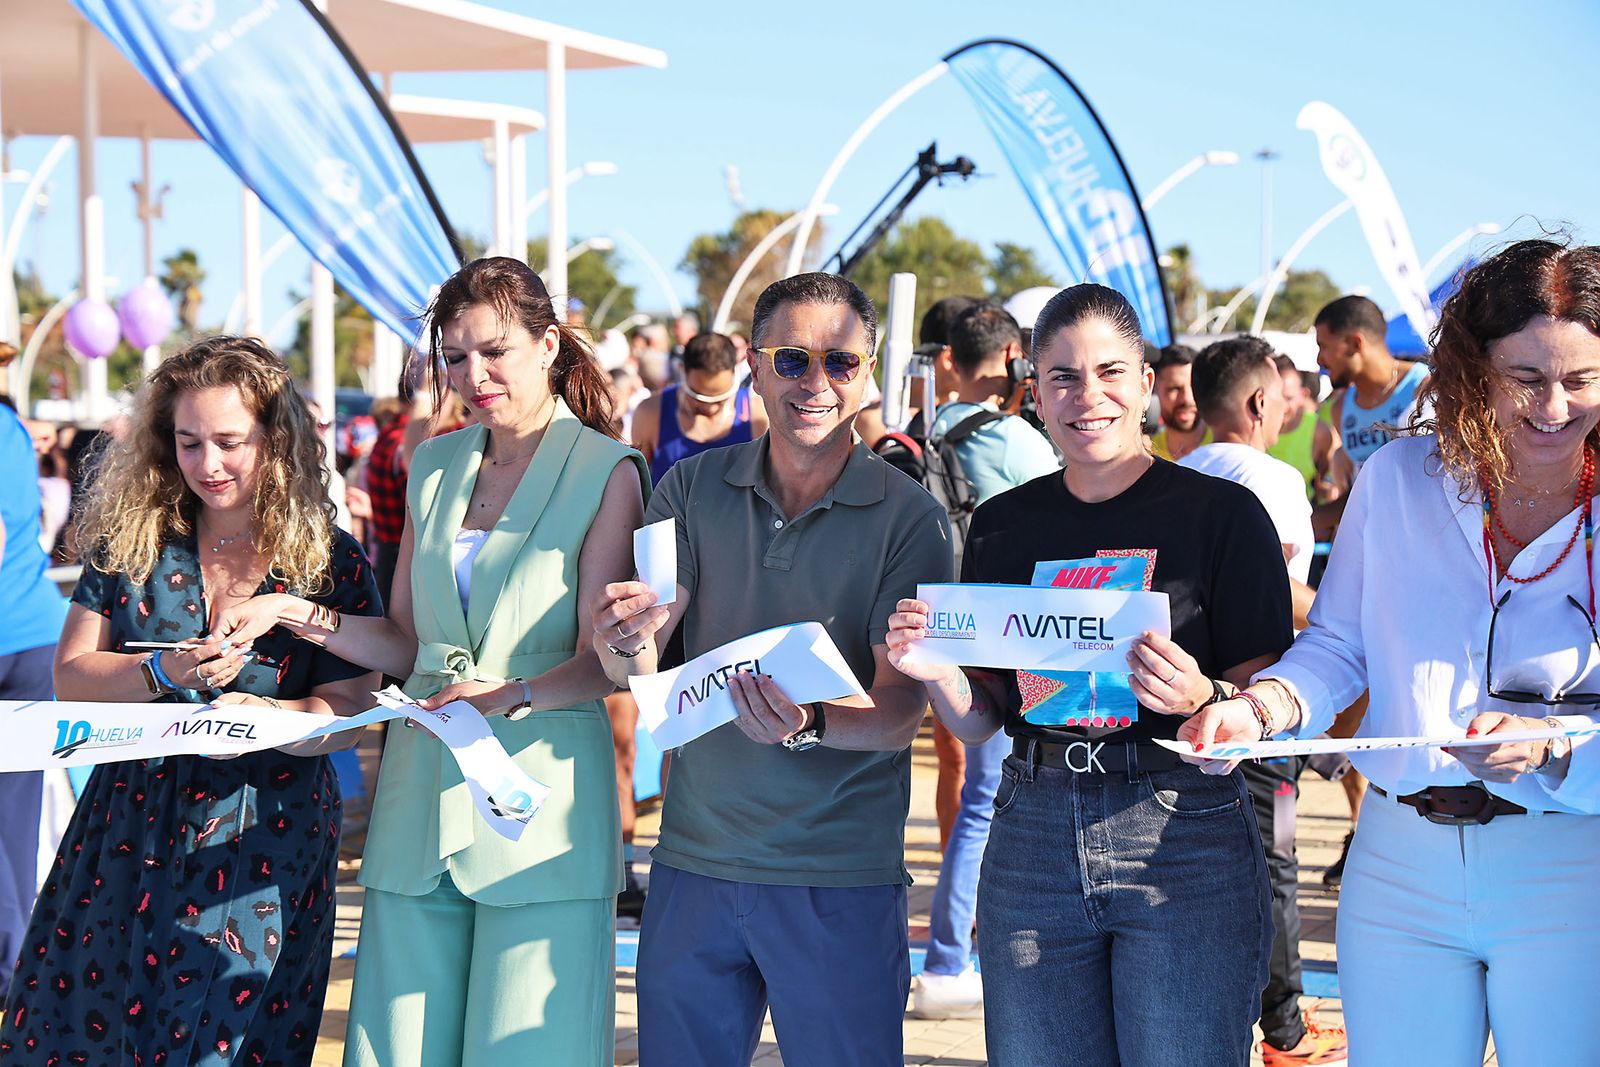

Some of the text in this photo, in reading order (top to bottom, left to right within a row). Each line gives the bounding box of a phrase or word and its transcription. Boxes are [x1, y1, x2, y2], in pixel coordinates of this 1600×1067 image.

[1051, 565, 1118, 589] NIKE
[926, 611, 1114, 641] UELVA AVATEL
[1072, 641, 1114, 651] TELECOM
[677, 659, 772, 715] AVATEL
[87, 726, 144, 743] HUELVA
[161, 719, 258, 740] AVATEL
[1064, 741, 1107, 774] CK
